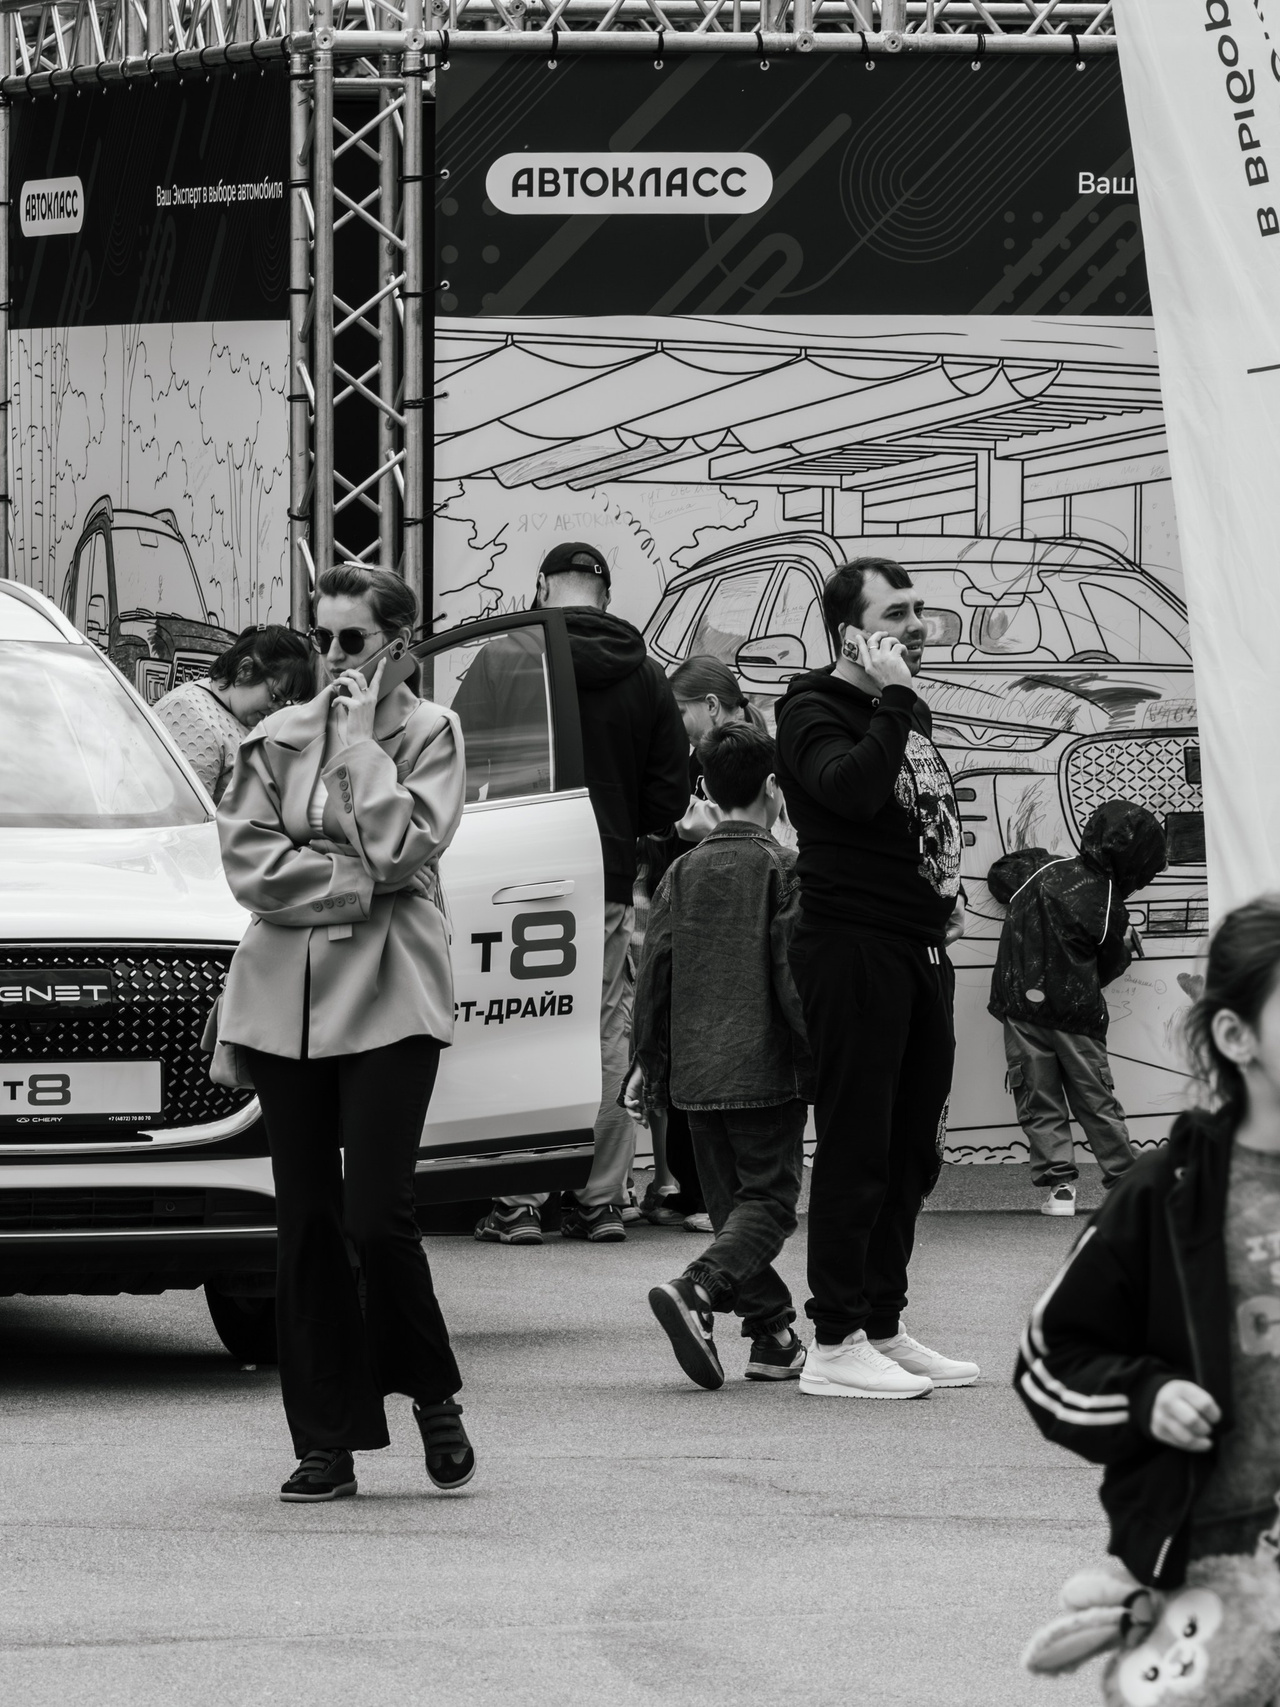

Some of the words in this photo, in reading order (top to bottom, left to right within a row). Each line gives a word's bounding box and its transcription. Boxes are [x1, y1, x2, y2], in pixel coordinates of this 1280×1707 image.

[156, 185, 172, 206] Ваш
[172, 183, 202, 209] Эксперт
[202, 186, 208, 203] в
[208, 178, 237, 207] выборе
[237, 175, 283, 201] автомобиля
[512, 167, 747, 198] АВТОКЛАСС
[1078, 171, 1135, 194] Ваш
[25, 189, 79, 222] АВТОКЛАСС
[470, 909, 577, 981] T8
[3, 1073, 72, 1106] T8
[32, 1116, 63, 1124] CHERY
